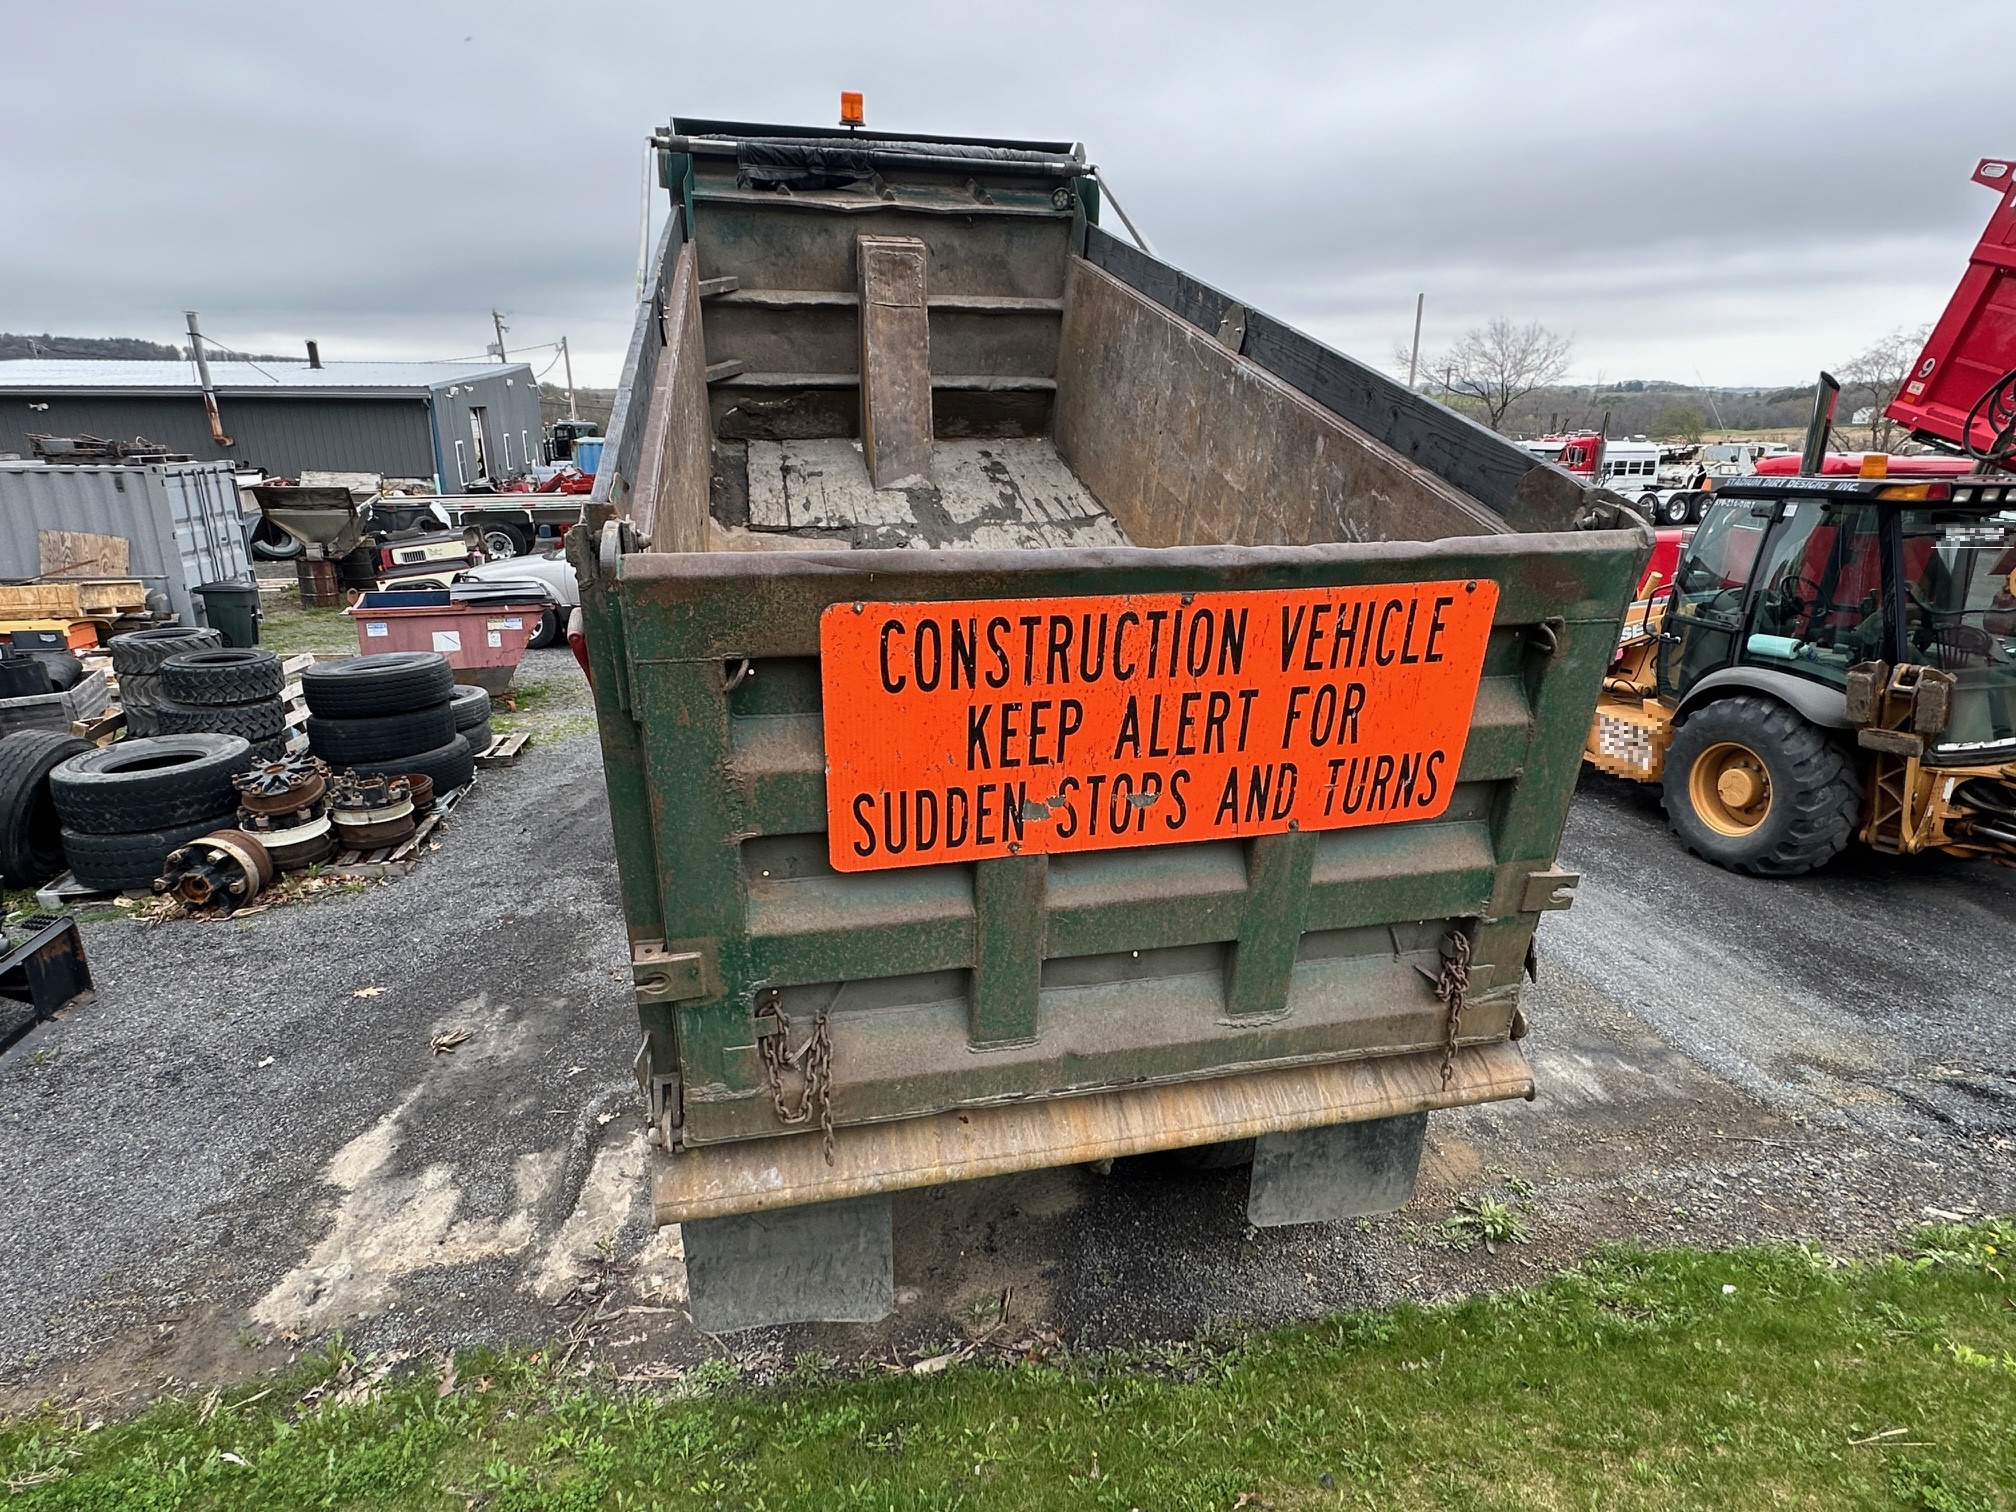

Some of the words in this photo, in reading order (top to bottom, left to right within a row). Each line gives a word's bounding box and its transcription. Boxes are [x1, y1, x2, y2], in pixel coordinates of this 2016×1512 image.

[1918, 357, 1936, 378] 9
[1725, 478, 1762, 488] STADIUM
[1762, 479, 1786, 488] DIRT
[1786, 480, 1831, 489] DESIGNS
[1834, 482, 1859, 492] INC.
[880, 608, 1250, 693] CONSTRUCTION
[1279, 597, 1454, 674] VEHICLE
[966, 698, 1083, 770] KEEP
[1114, 689, 1260, 759] ALERT
[1282, 683, 1366, 748] FOR
[852, 781, 1026, 856] SUDDEN
[1058, 770, 1191, 838] STOPS
[1215, 762, 1298, 825] AND
[1323, 751, 1445, 815] TURNS
